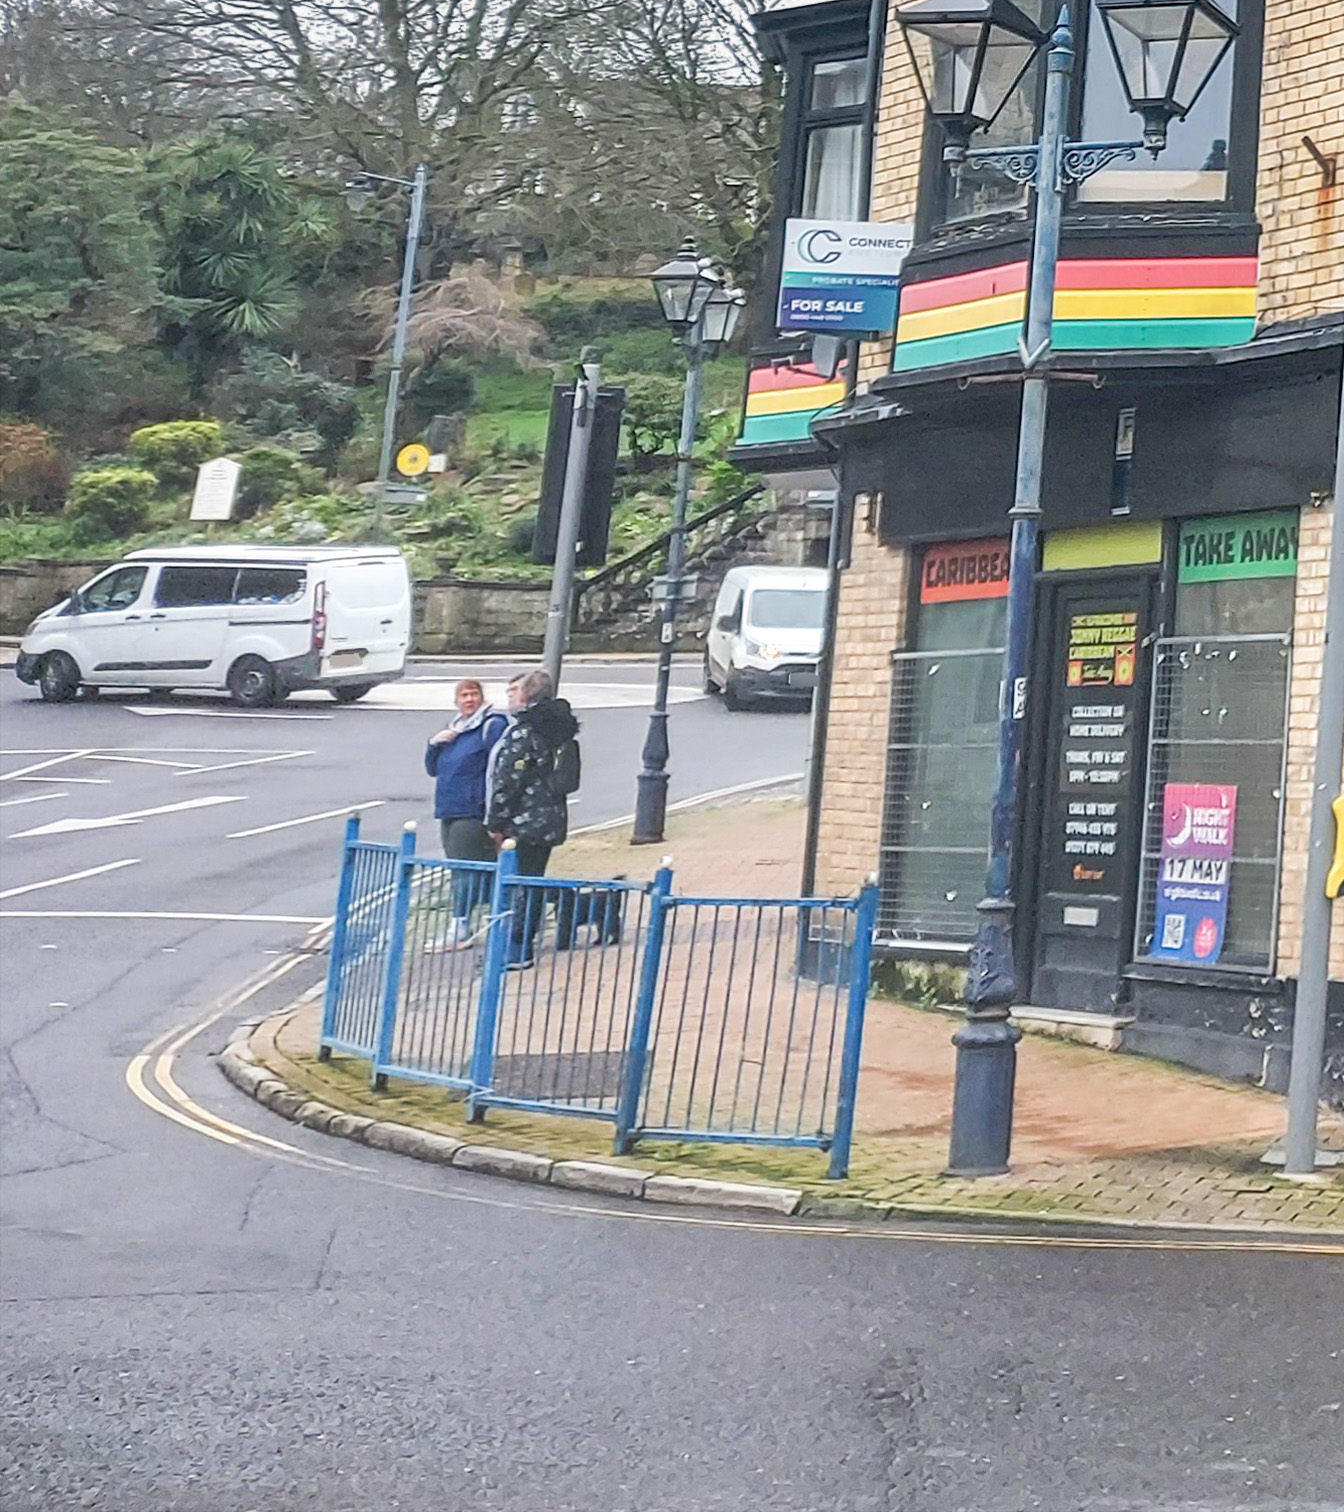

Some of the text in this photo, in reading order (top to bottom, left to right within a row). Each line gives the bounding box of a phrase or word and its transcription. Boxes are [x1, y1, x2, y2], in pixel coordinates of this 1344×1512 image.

[848, 237, 912, 249] CONNECT
[791, 299, 865, 313] FOR SALE
[1184, 531, 1234, 567] TAKE
[926, 552, 1010, 587] CARIBBEA
[1193, 808, 1230, 826] NIGHT
[1192, 827, 1229, 845] WALK
[1168, 858, 1224, 881] 17 MAY
